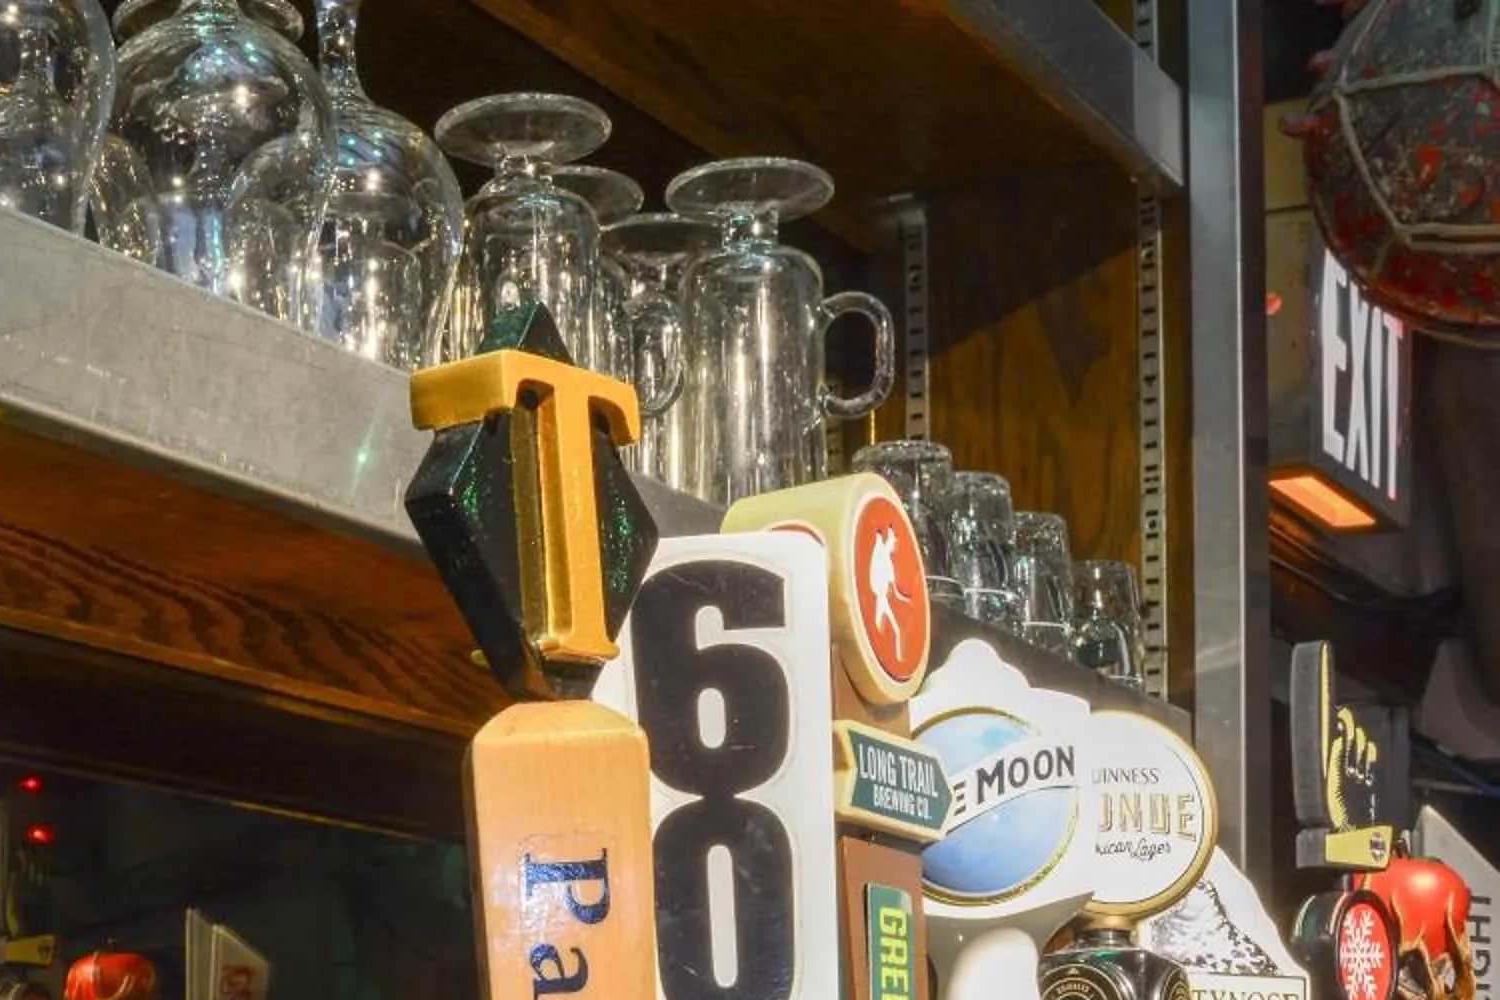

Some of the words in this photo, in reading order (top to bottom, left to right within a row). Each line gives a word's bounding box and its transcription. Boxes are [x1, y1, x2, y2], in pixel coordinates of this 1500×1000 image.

[1321, 248, 1404, 500] EXIT
[858, 743, 897, 786] LONG
[899, 755, 939, 798] TRAIL
[976, 745, 1075, 805] MOON
[873, 783, 915, 816] BREWING
